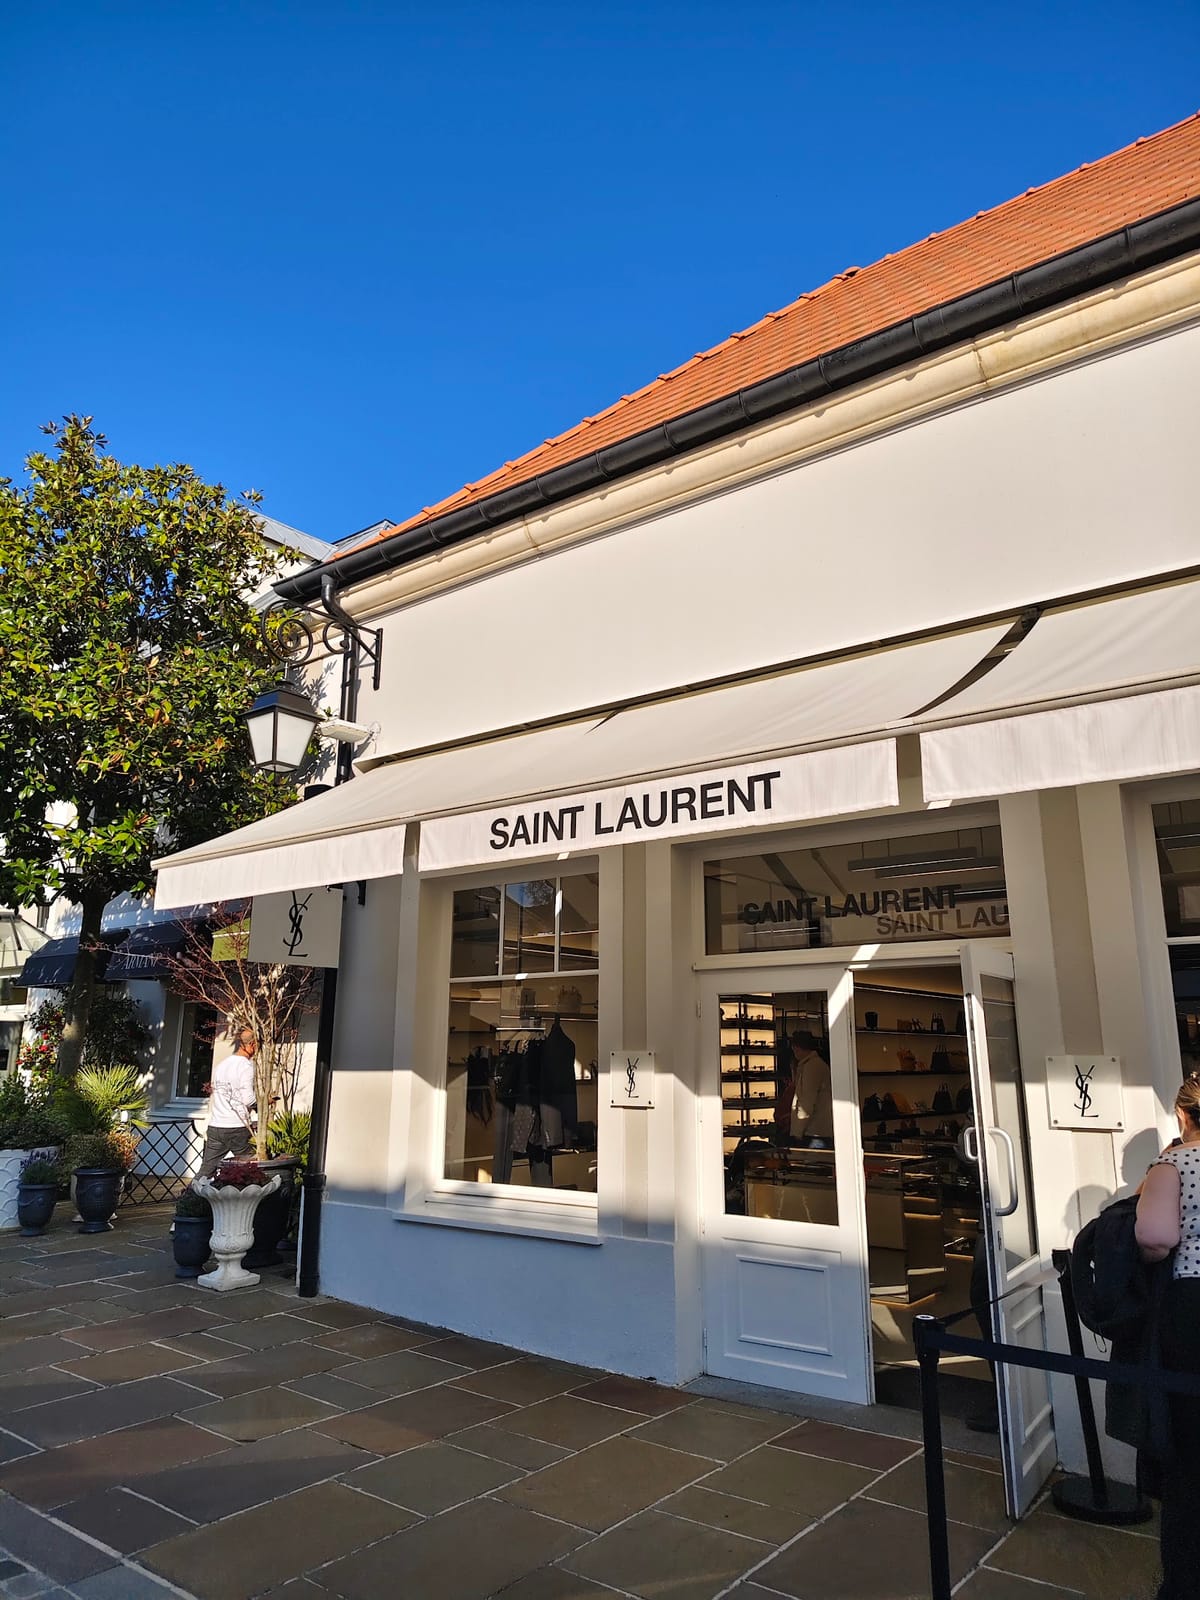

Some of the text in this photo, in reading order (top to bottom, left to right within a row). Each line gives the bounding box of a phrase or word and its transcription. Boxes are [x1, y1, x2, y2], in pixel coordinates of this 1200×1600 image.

[489, 771, 781, 850] SAINT LAURENT
[743, 884, 961, 925] SAINT LAURENT
[876, 910, 948, 935] SAINT
